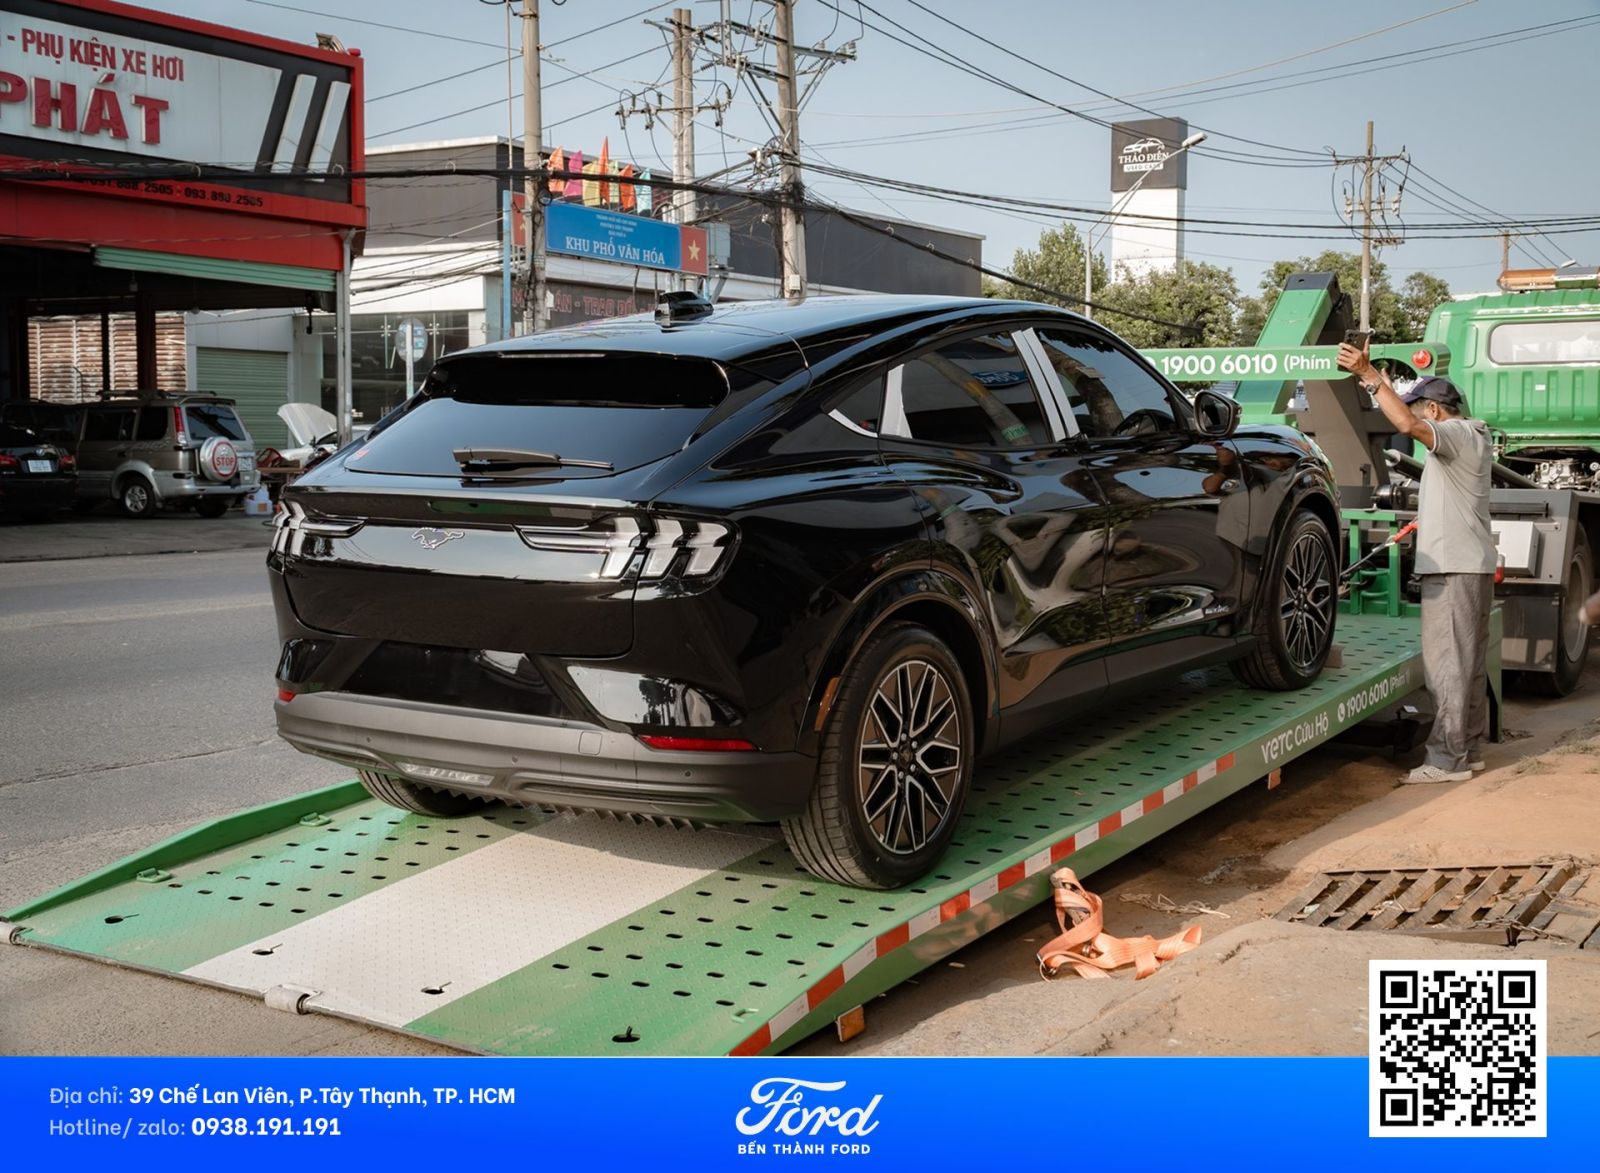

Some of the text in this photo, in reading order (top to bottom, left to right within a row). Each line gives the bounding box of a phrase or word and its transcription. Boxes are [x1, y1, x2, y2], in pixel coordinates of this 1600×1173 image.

[22, 28, 64, 64] PHỤ
[69, 36, 117, 71] KIỆN
[122, 48, 147, 75] XE
[152, 53, 185, 81] HƠI
[0, 70, 170, 145] PHÁT
[1118, 153, 1145, 164] THẢO
[565, 236, 665, 264] KHU PHỐ VĂN HÓA
[1161, 354, 1331, 375] 1900 6010 (Phím
[216, 456, 235, 467] STOP
[1346, 690, 1368, 719] 1900
[1369, 678, 1390, 707] 6010
[1295, 721, 1315, 747] Cứu
[1315, 711, 1330, 737] Hộ
